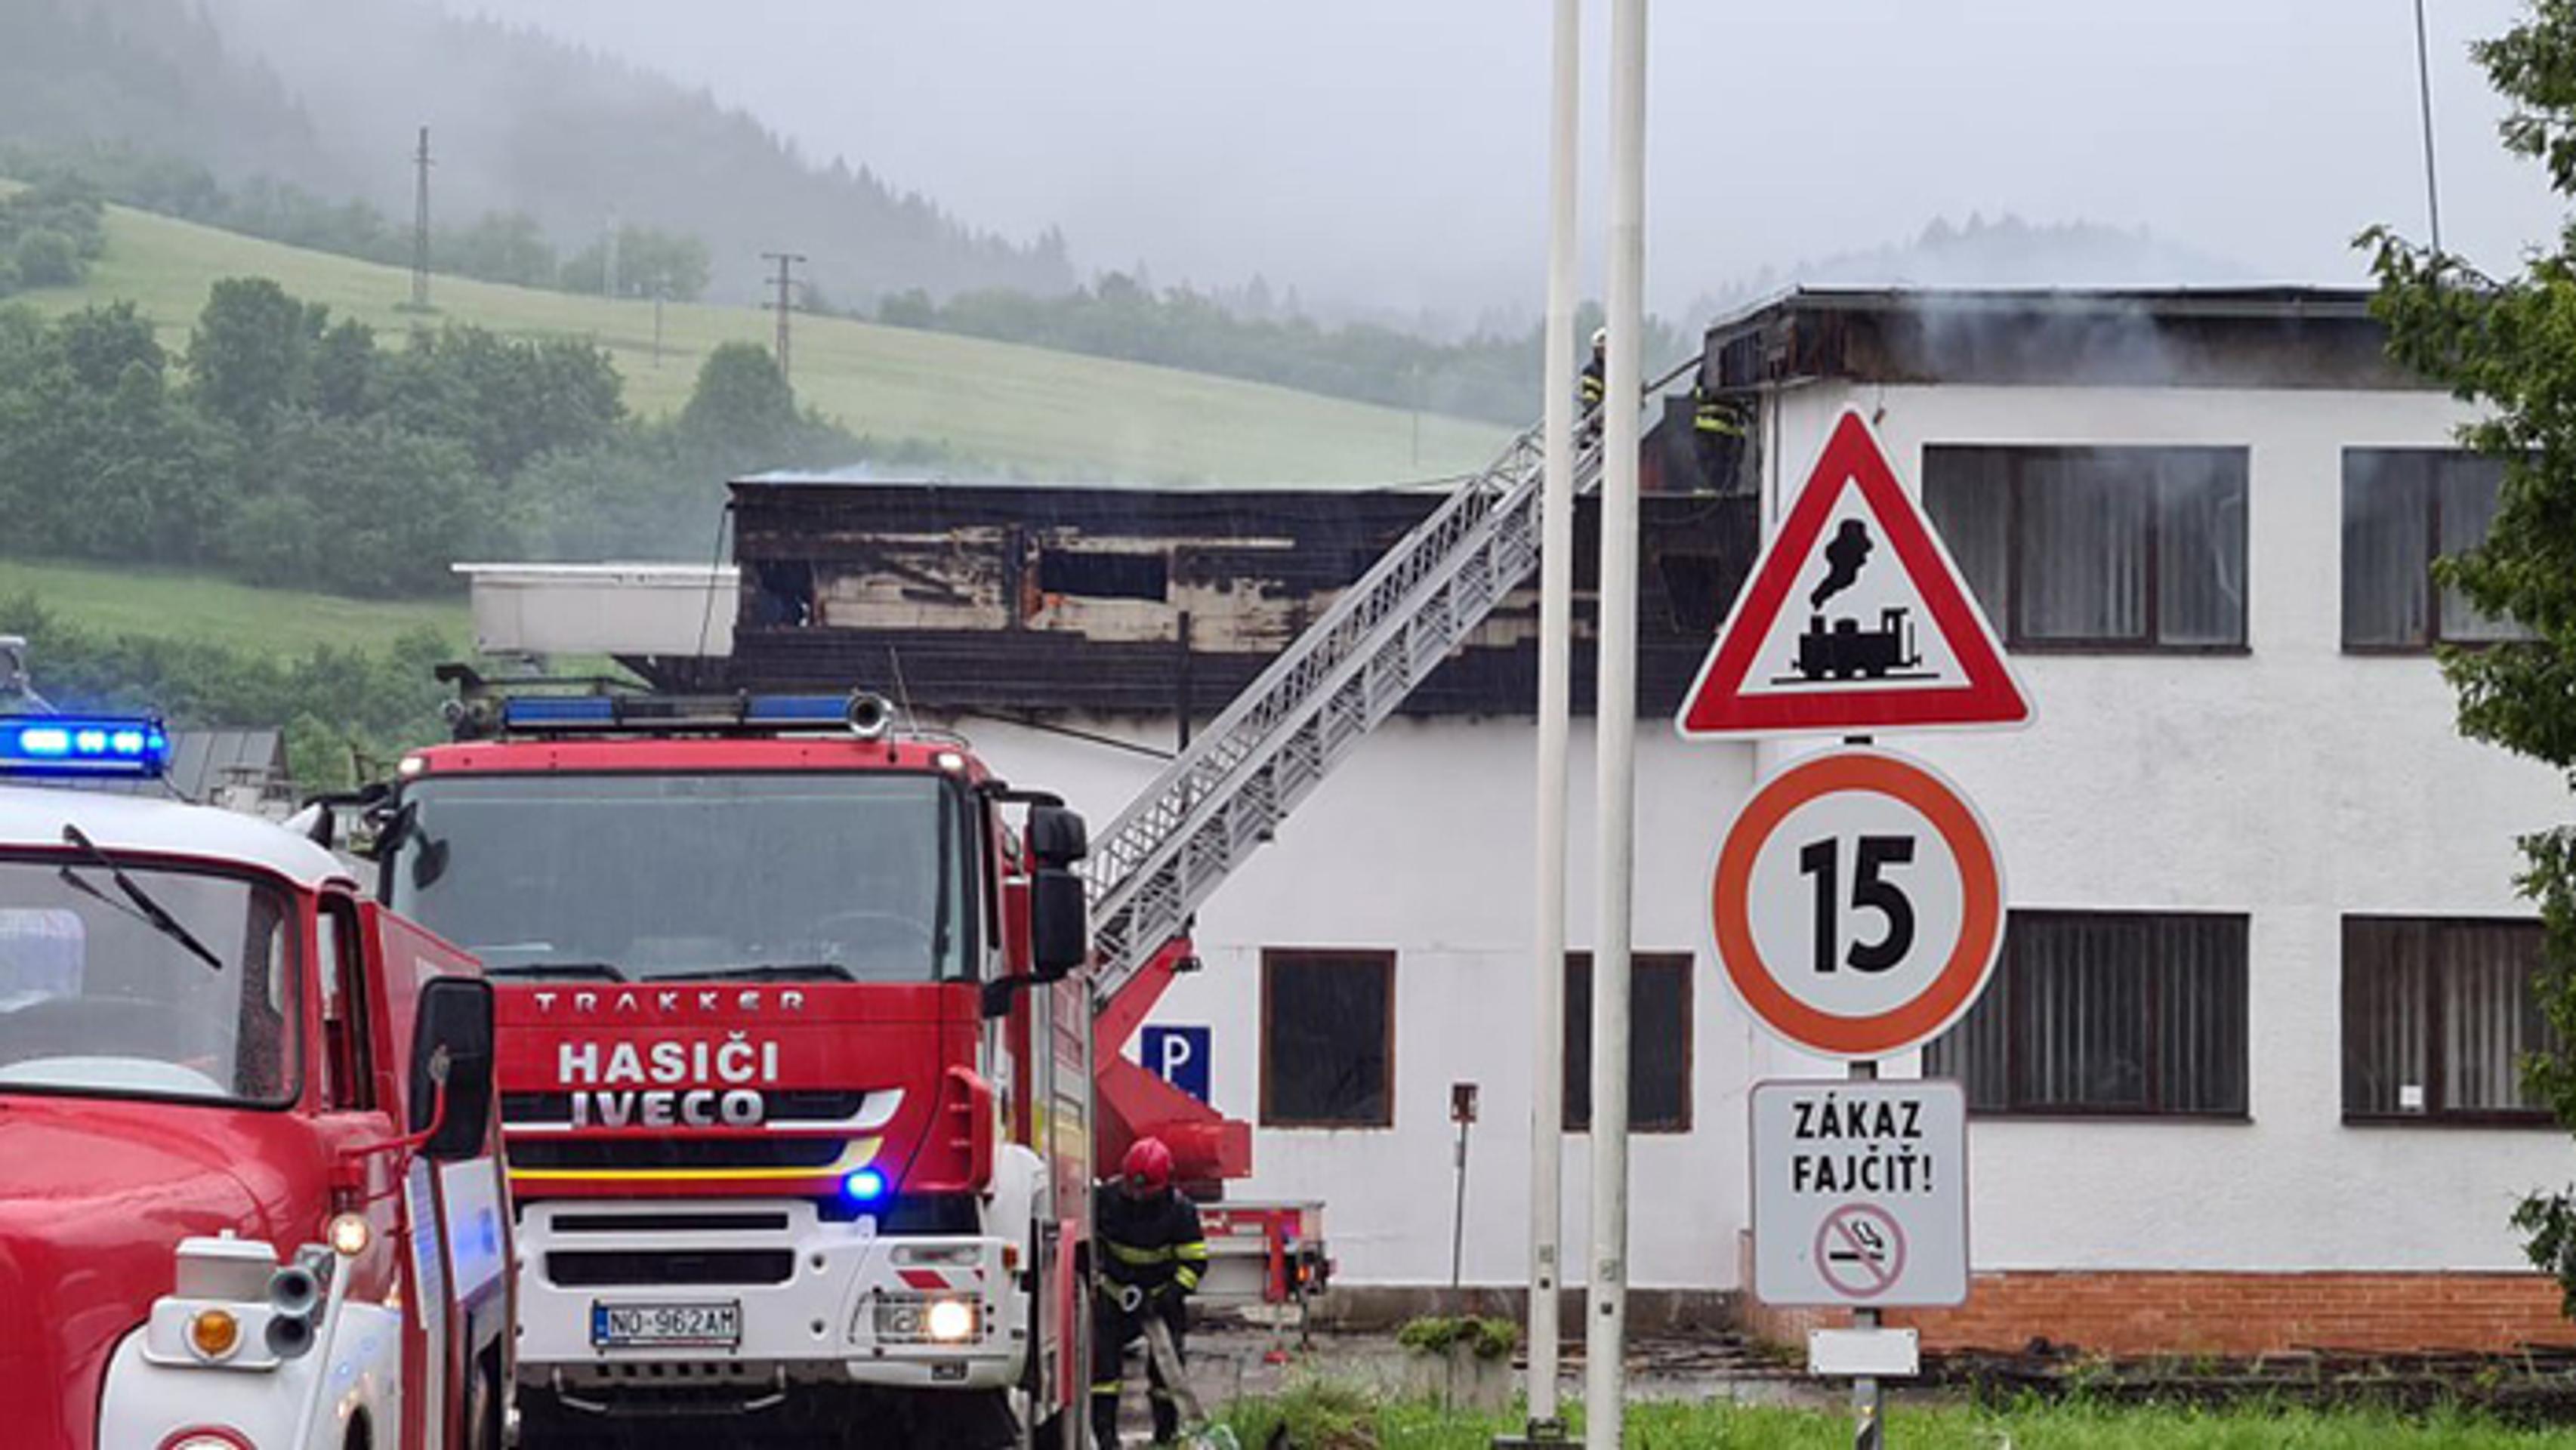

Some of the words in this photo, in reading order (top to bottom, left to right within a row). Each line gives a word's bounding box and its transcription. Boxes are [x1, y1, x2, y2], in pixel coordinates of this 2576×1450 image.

[1800, 836, 1914, 972] 15
[535, 991, 806, 1010] TRAKKER
[559, 1031, 779, 1083] HASIČI
[1163, 1034, 1191, 1083] P
[569, 1090, 764, 1128] IVECO
[1793, 1092, 1922, 1139] ZÁKAZ
[1793, 1144, 1933, 1192] FAJČIŤ!
